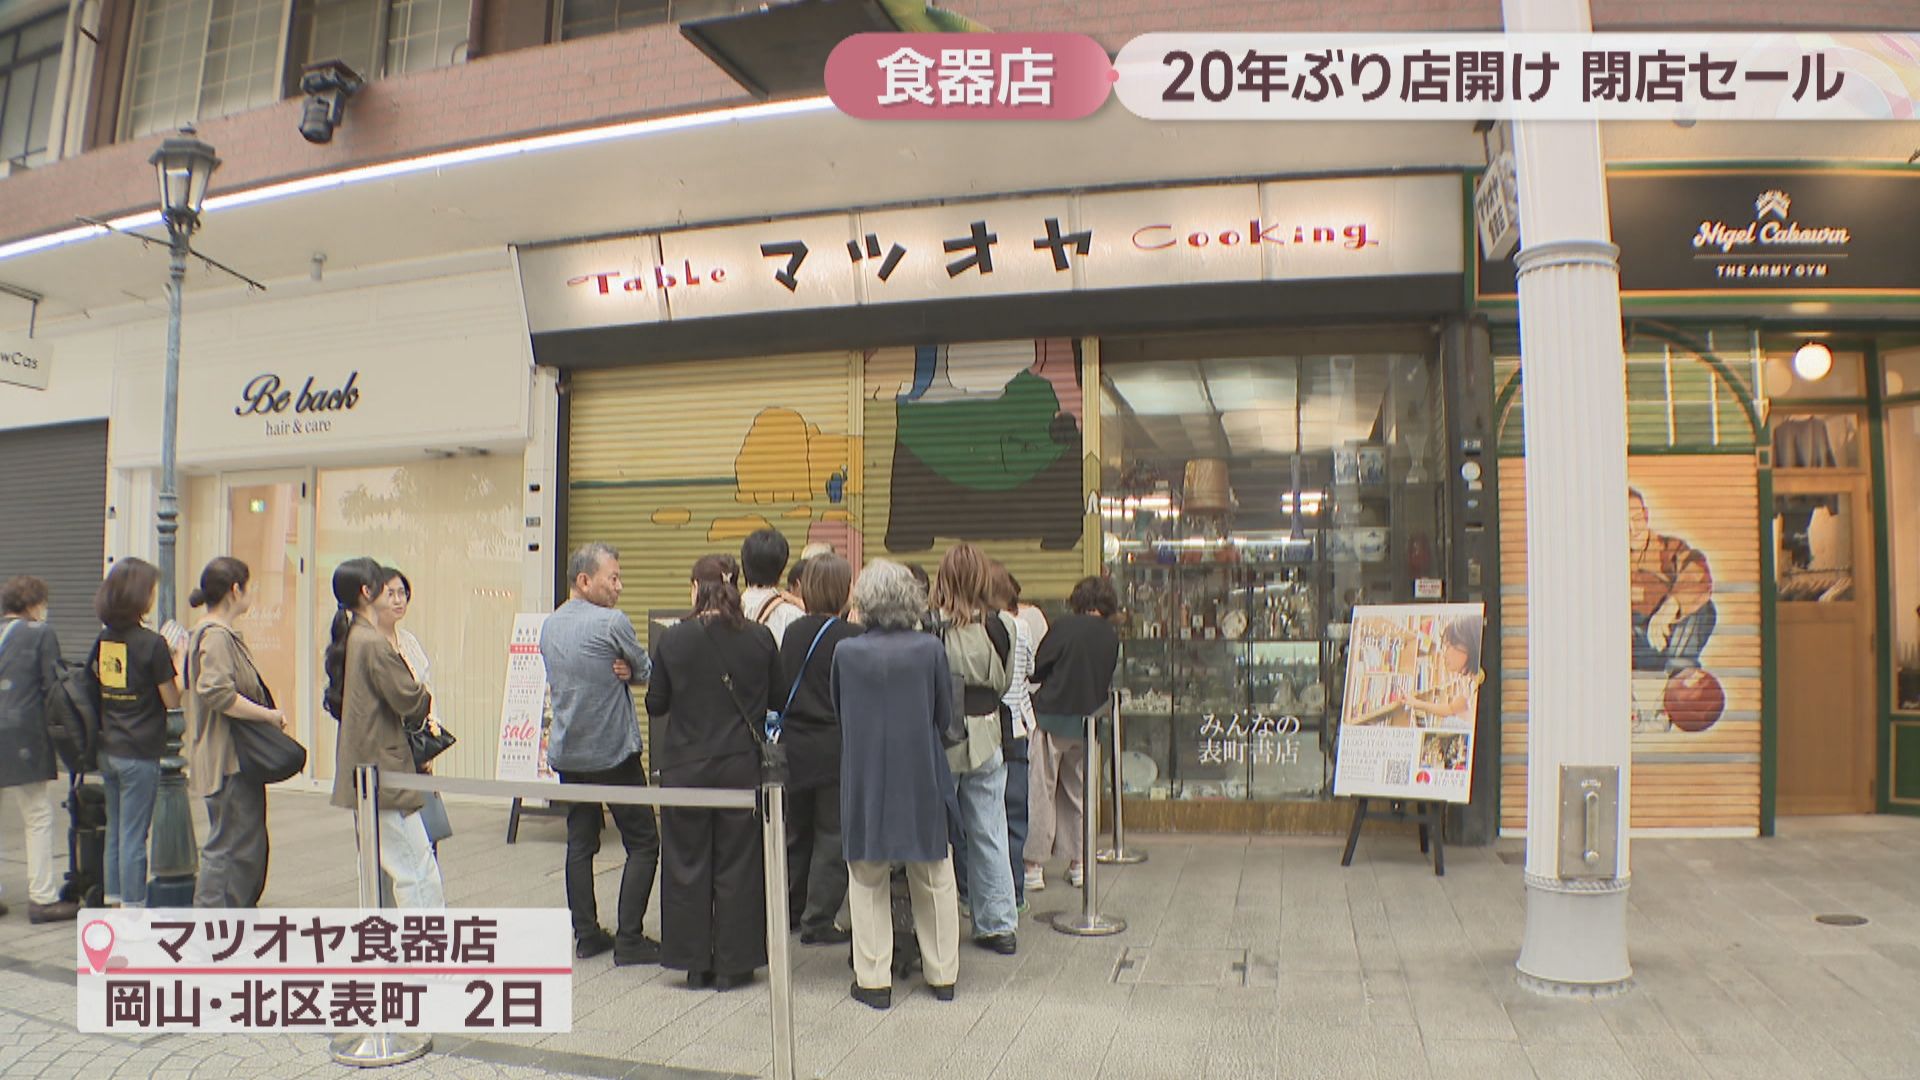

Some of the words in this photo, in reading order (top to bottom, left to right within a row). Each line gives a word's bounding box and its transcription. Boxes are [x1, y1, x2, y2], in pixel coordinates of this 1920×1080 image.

[1693, 222, 1757, 252] Nigel
[760, 217, 1092, 293] マツオヤ
[1132, 219, 1379, 250] Cooking
[1717, 264, 1746, 277] THE
[1749, 264, 1791, 277] ARMY
[1795, 264, 1828, 277] GYM
[235, 374, 291, 416] Be
[295, 371, 359, 413] back
[265, 420, 290, 436] hair
[292, 419, 302, 434] &
[305, 420, 331, 433] care
[502, 719, 536, 740] sale
[1200, 712, 1299, 737] みんなの
[1199, 738, 1299, 765] 表町書店
